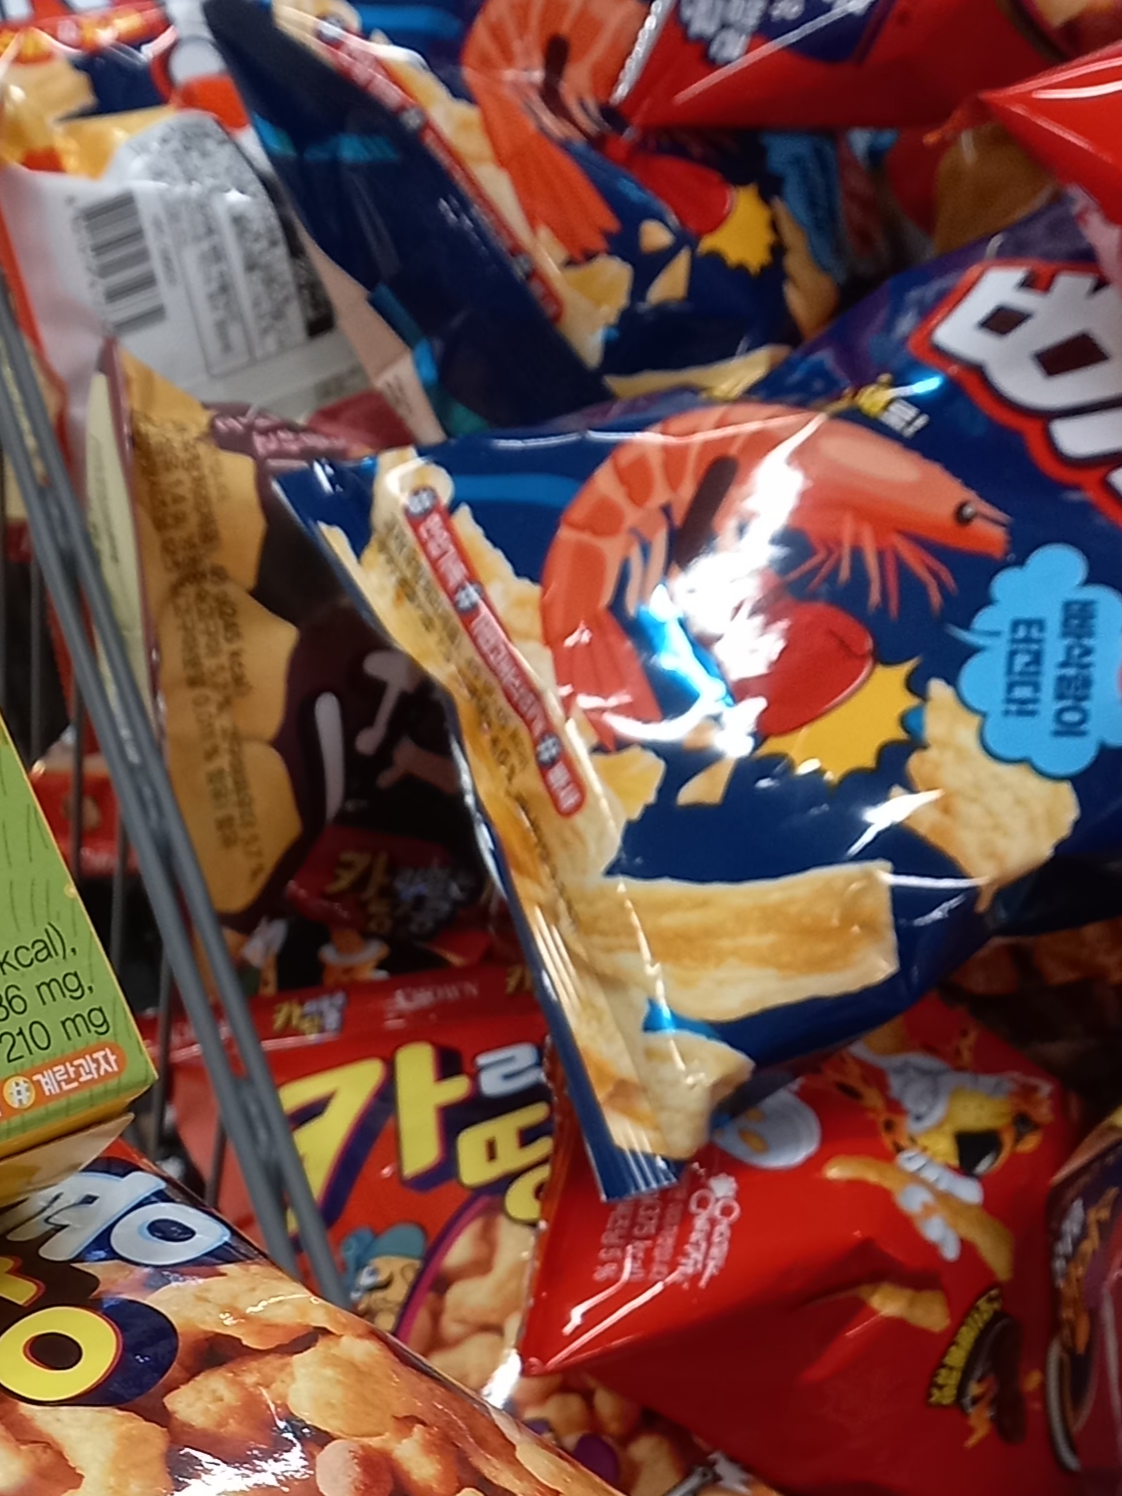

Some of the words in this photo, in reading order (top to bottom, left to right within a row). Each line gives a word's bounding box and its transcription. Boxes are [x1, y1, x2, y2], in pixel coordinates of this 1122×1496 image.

[1003, 617, 1045, 717] 터진다!
[35, 968, 95, 1006] mg,
[60, 1004, 112, 1043] mg
